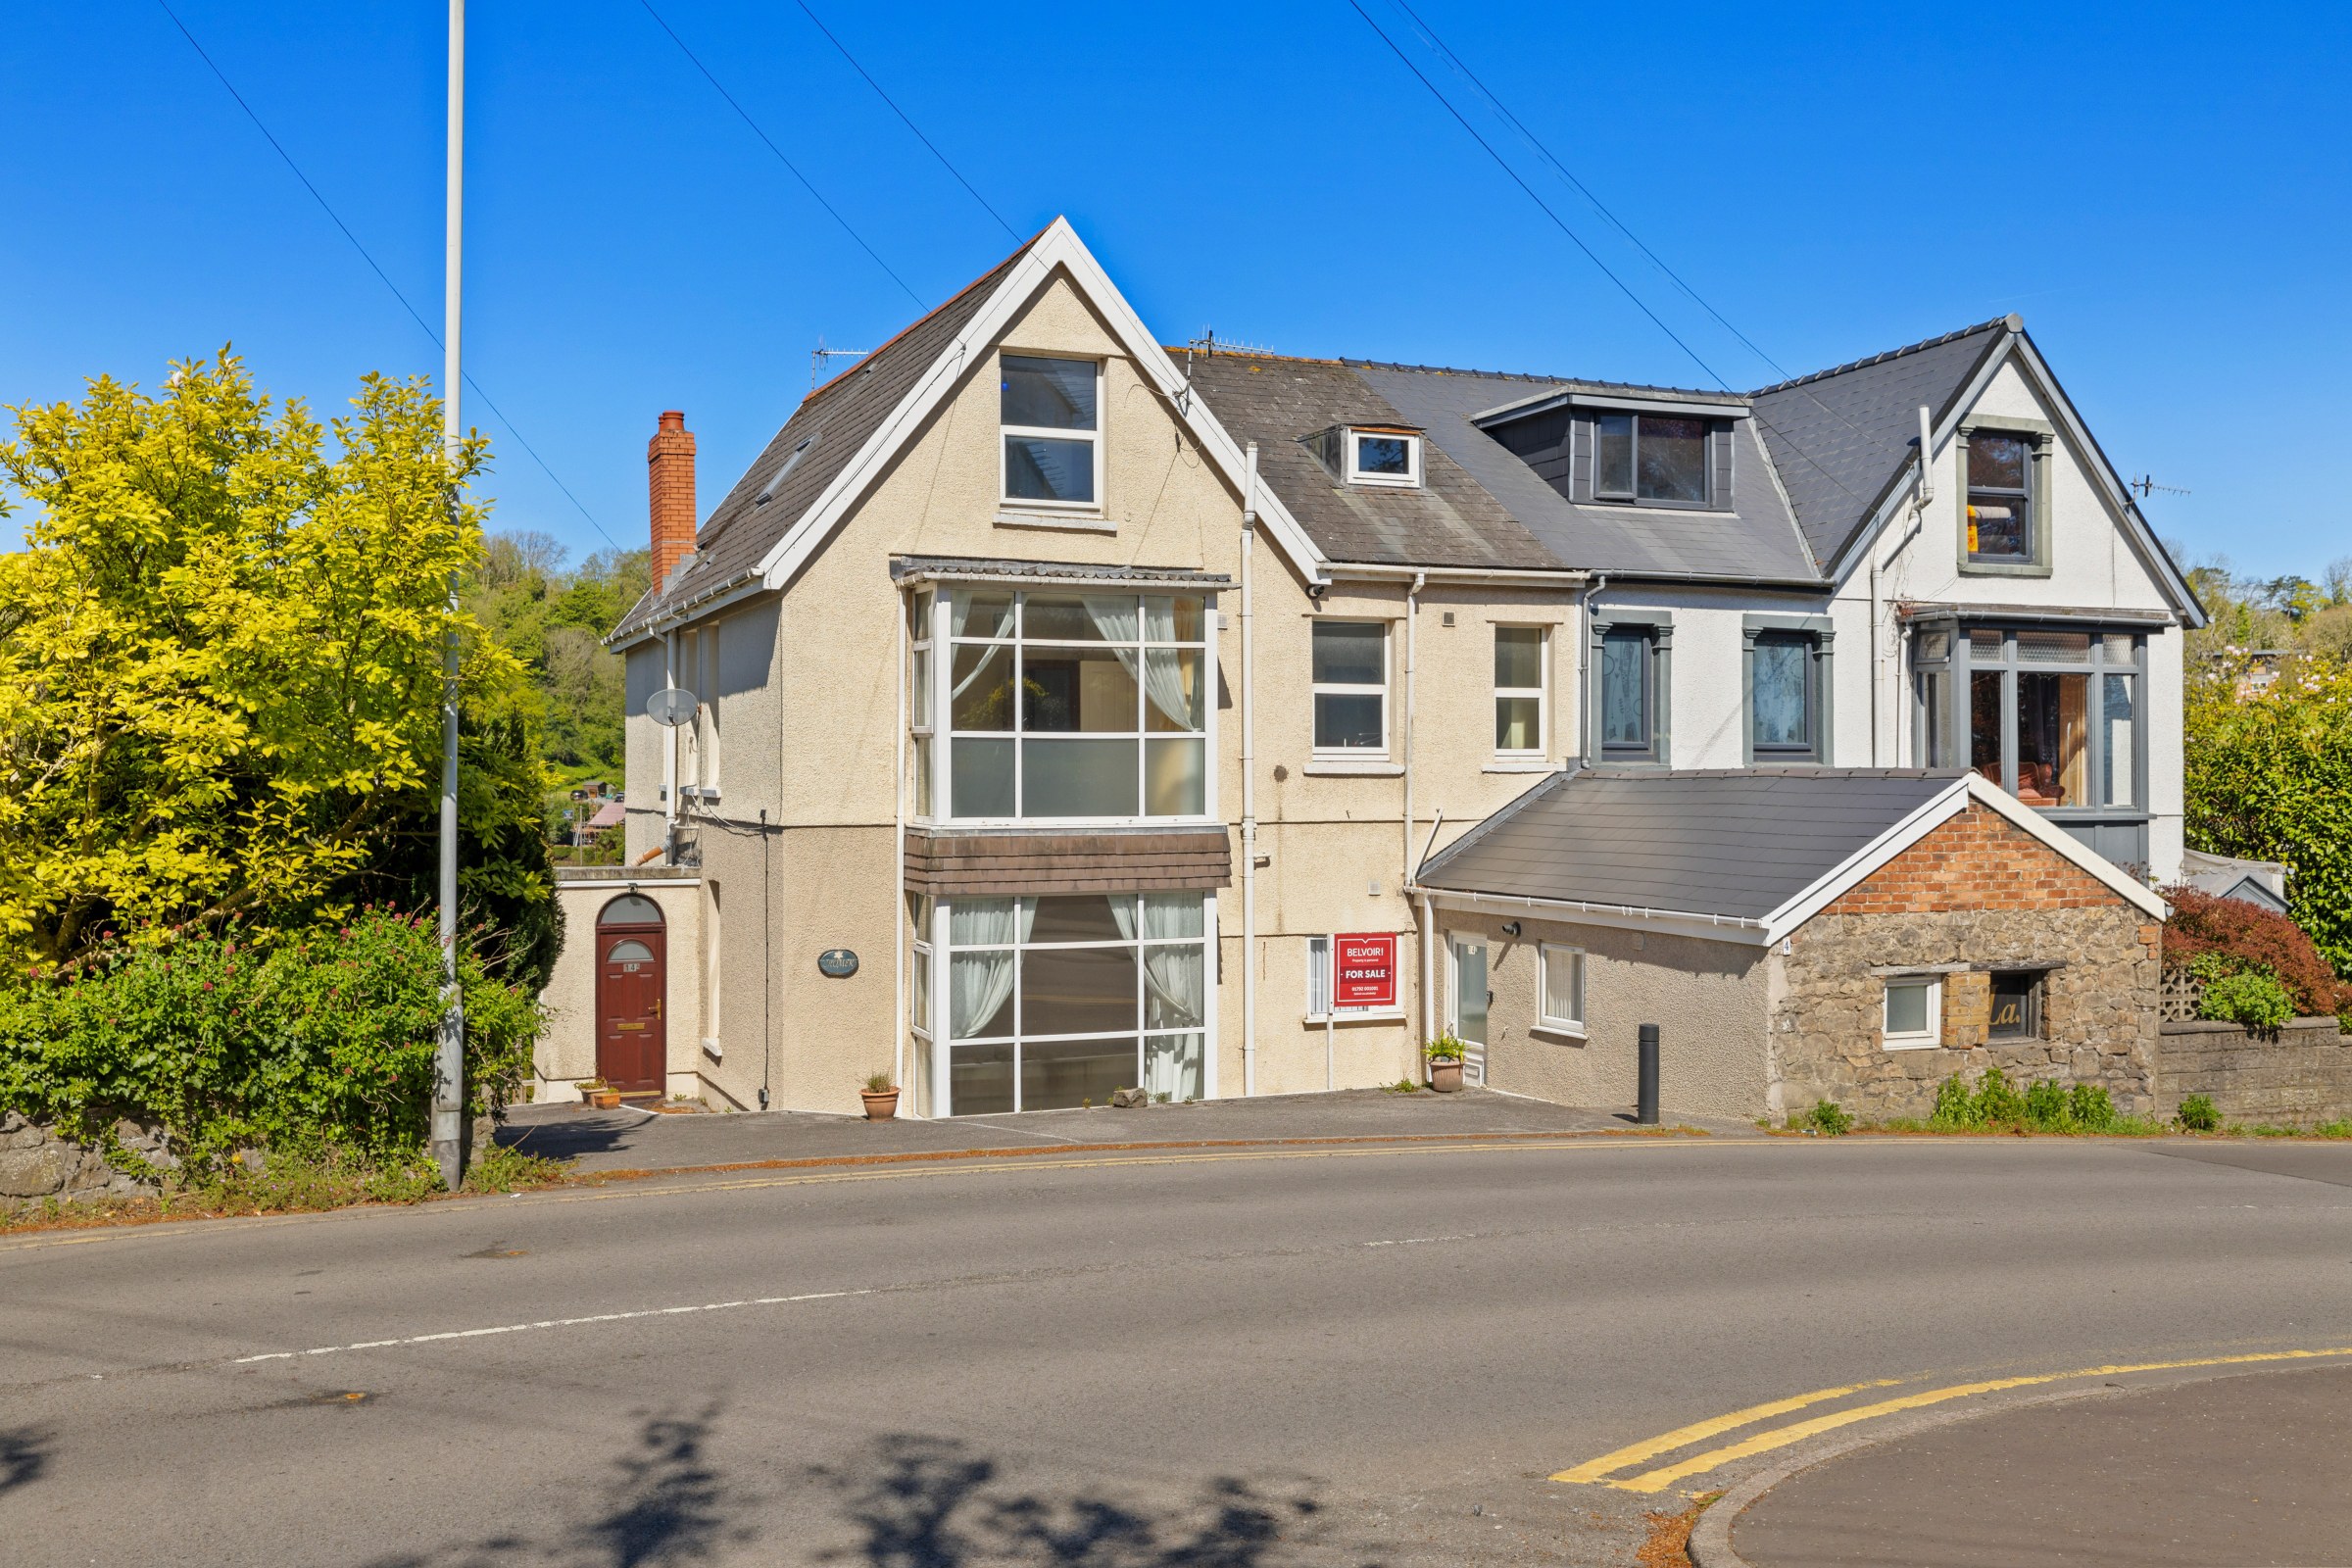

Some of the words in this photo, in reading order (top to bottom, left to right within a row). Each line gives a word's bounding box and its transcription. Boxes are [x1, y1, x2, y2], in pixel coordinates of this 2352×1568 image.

[1784, 941, 1789, 951] 4
[1347, 947, 1384, 956] BELVOIR!
[1346, 970, 1363, 979] FOR
[1364, 969, 1386, 978] SALE
